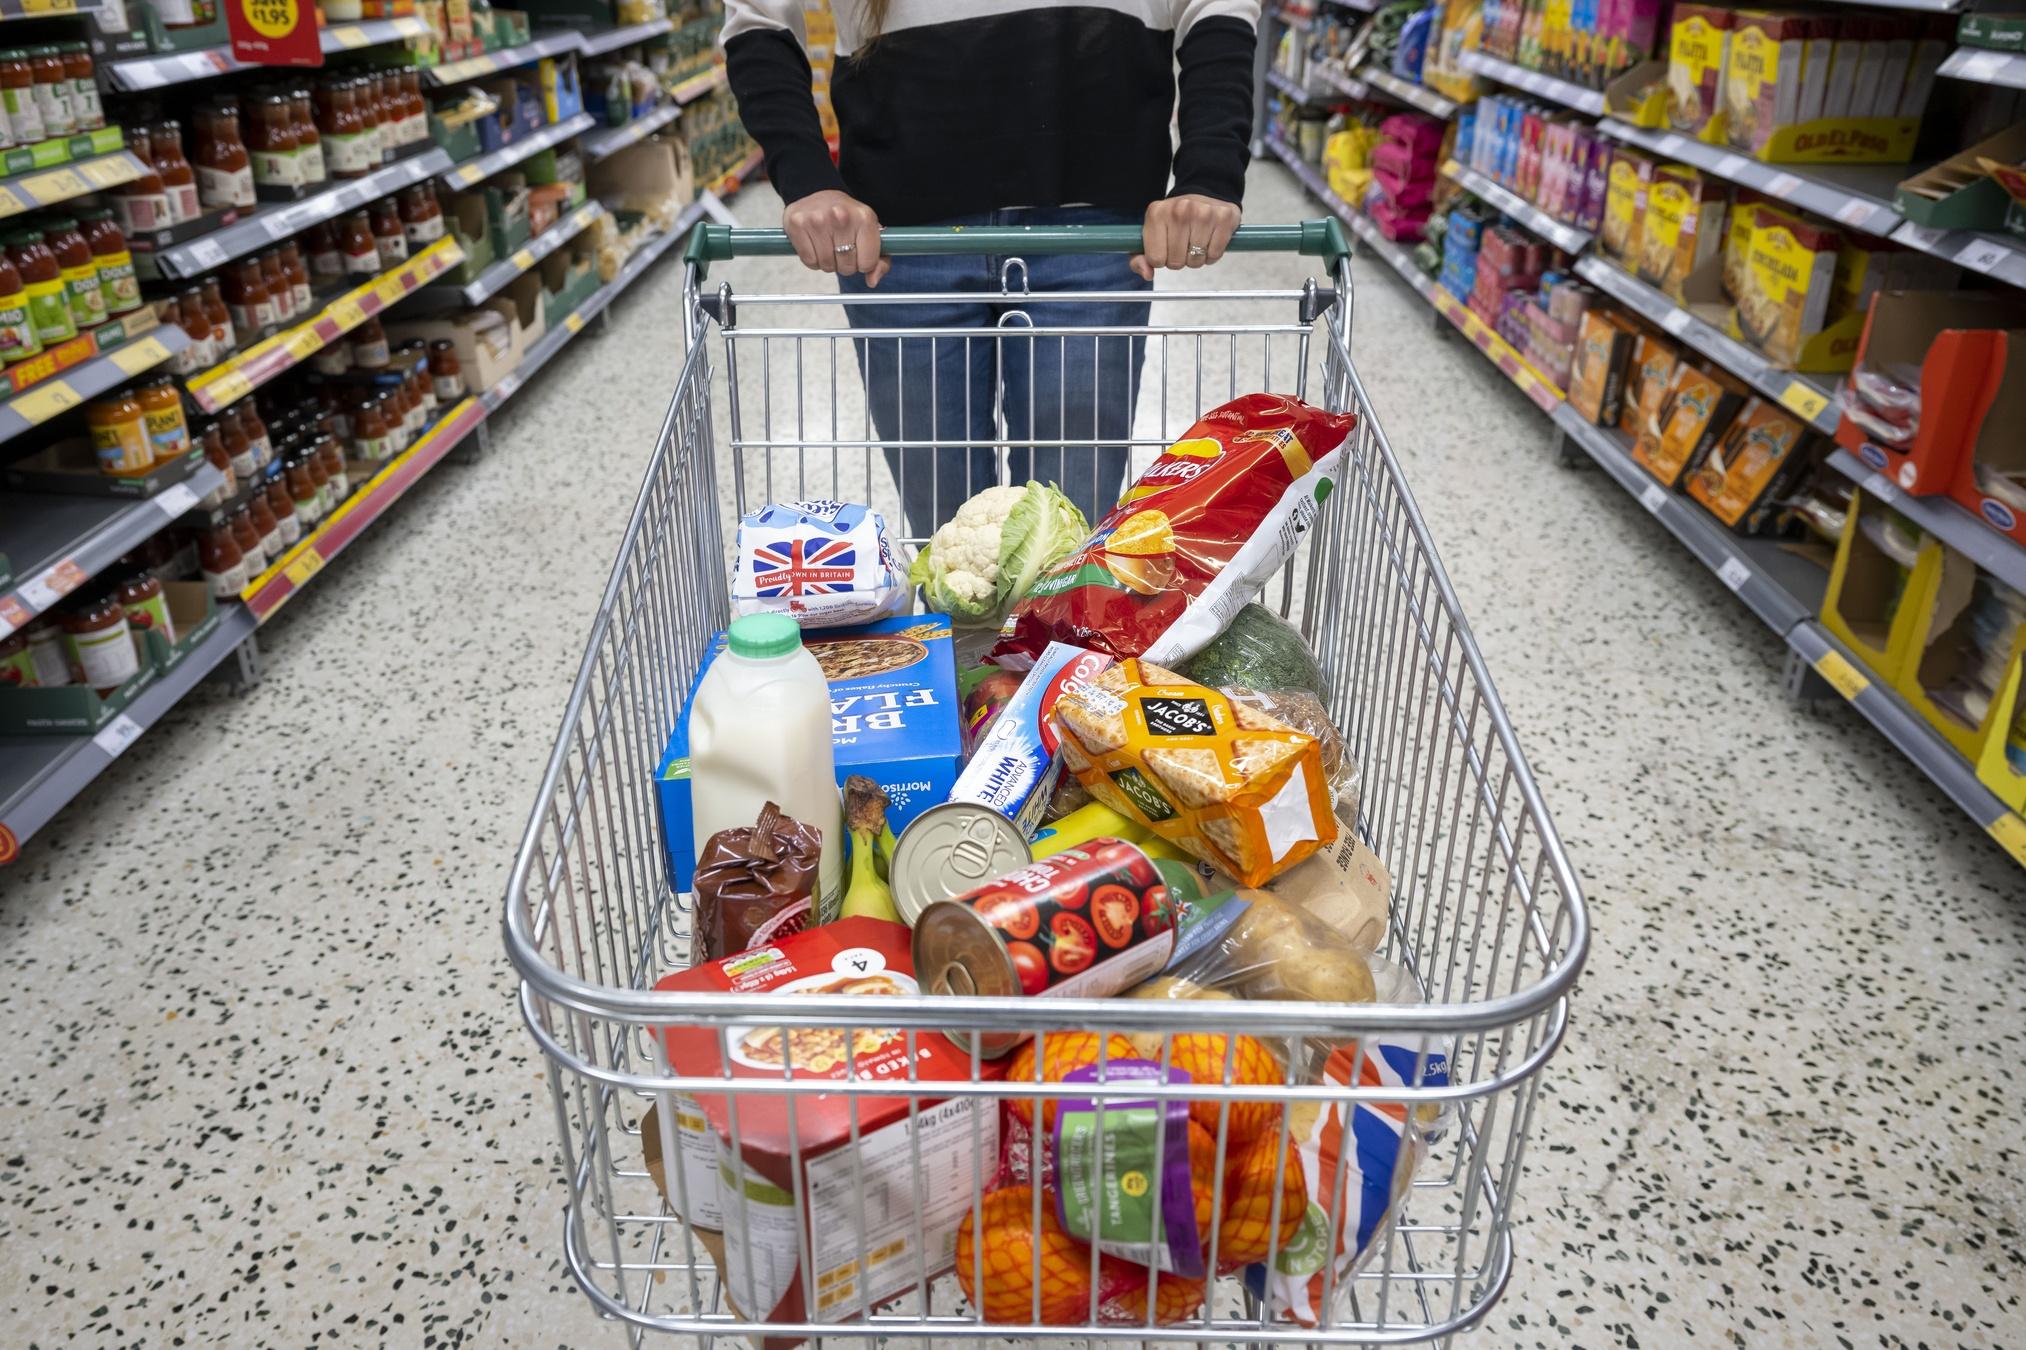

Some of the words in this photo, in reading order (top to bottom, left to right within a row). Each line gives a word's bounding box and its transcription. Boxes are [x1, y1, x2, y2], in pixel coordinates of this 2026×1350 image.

[253, 8, 290, 25] £1.95
[15, 352, 57, 389] FREE
[758, 572, 792, 586] Proudly
[809, 571, 818, 579] IN
[820, 571, 851, 579] BRITAIN
[847, 684, 878, 692] flakes
[880, 682, 920, 690] Crunchy
[1157, 688, 1185, 697] Cream
[831, 689, 939, 715] FLA
[832, 710, 906, 734] BR
[1147, 702, 1208, 733] JACOB'S
[881, 781, 931, 793] Morriso
[976, 756, 1018, 803] WHITE
[993, 760, 1028, 807] ADVANCED
[1118, 777, 1171, 814] JACOB'S
[851, 959, 868, 973] 4
[1103, 1132, 1122, 1226] TANGERINES
